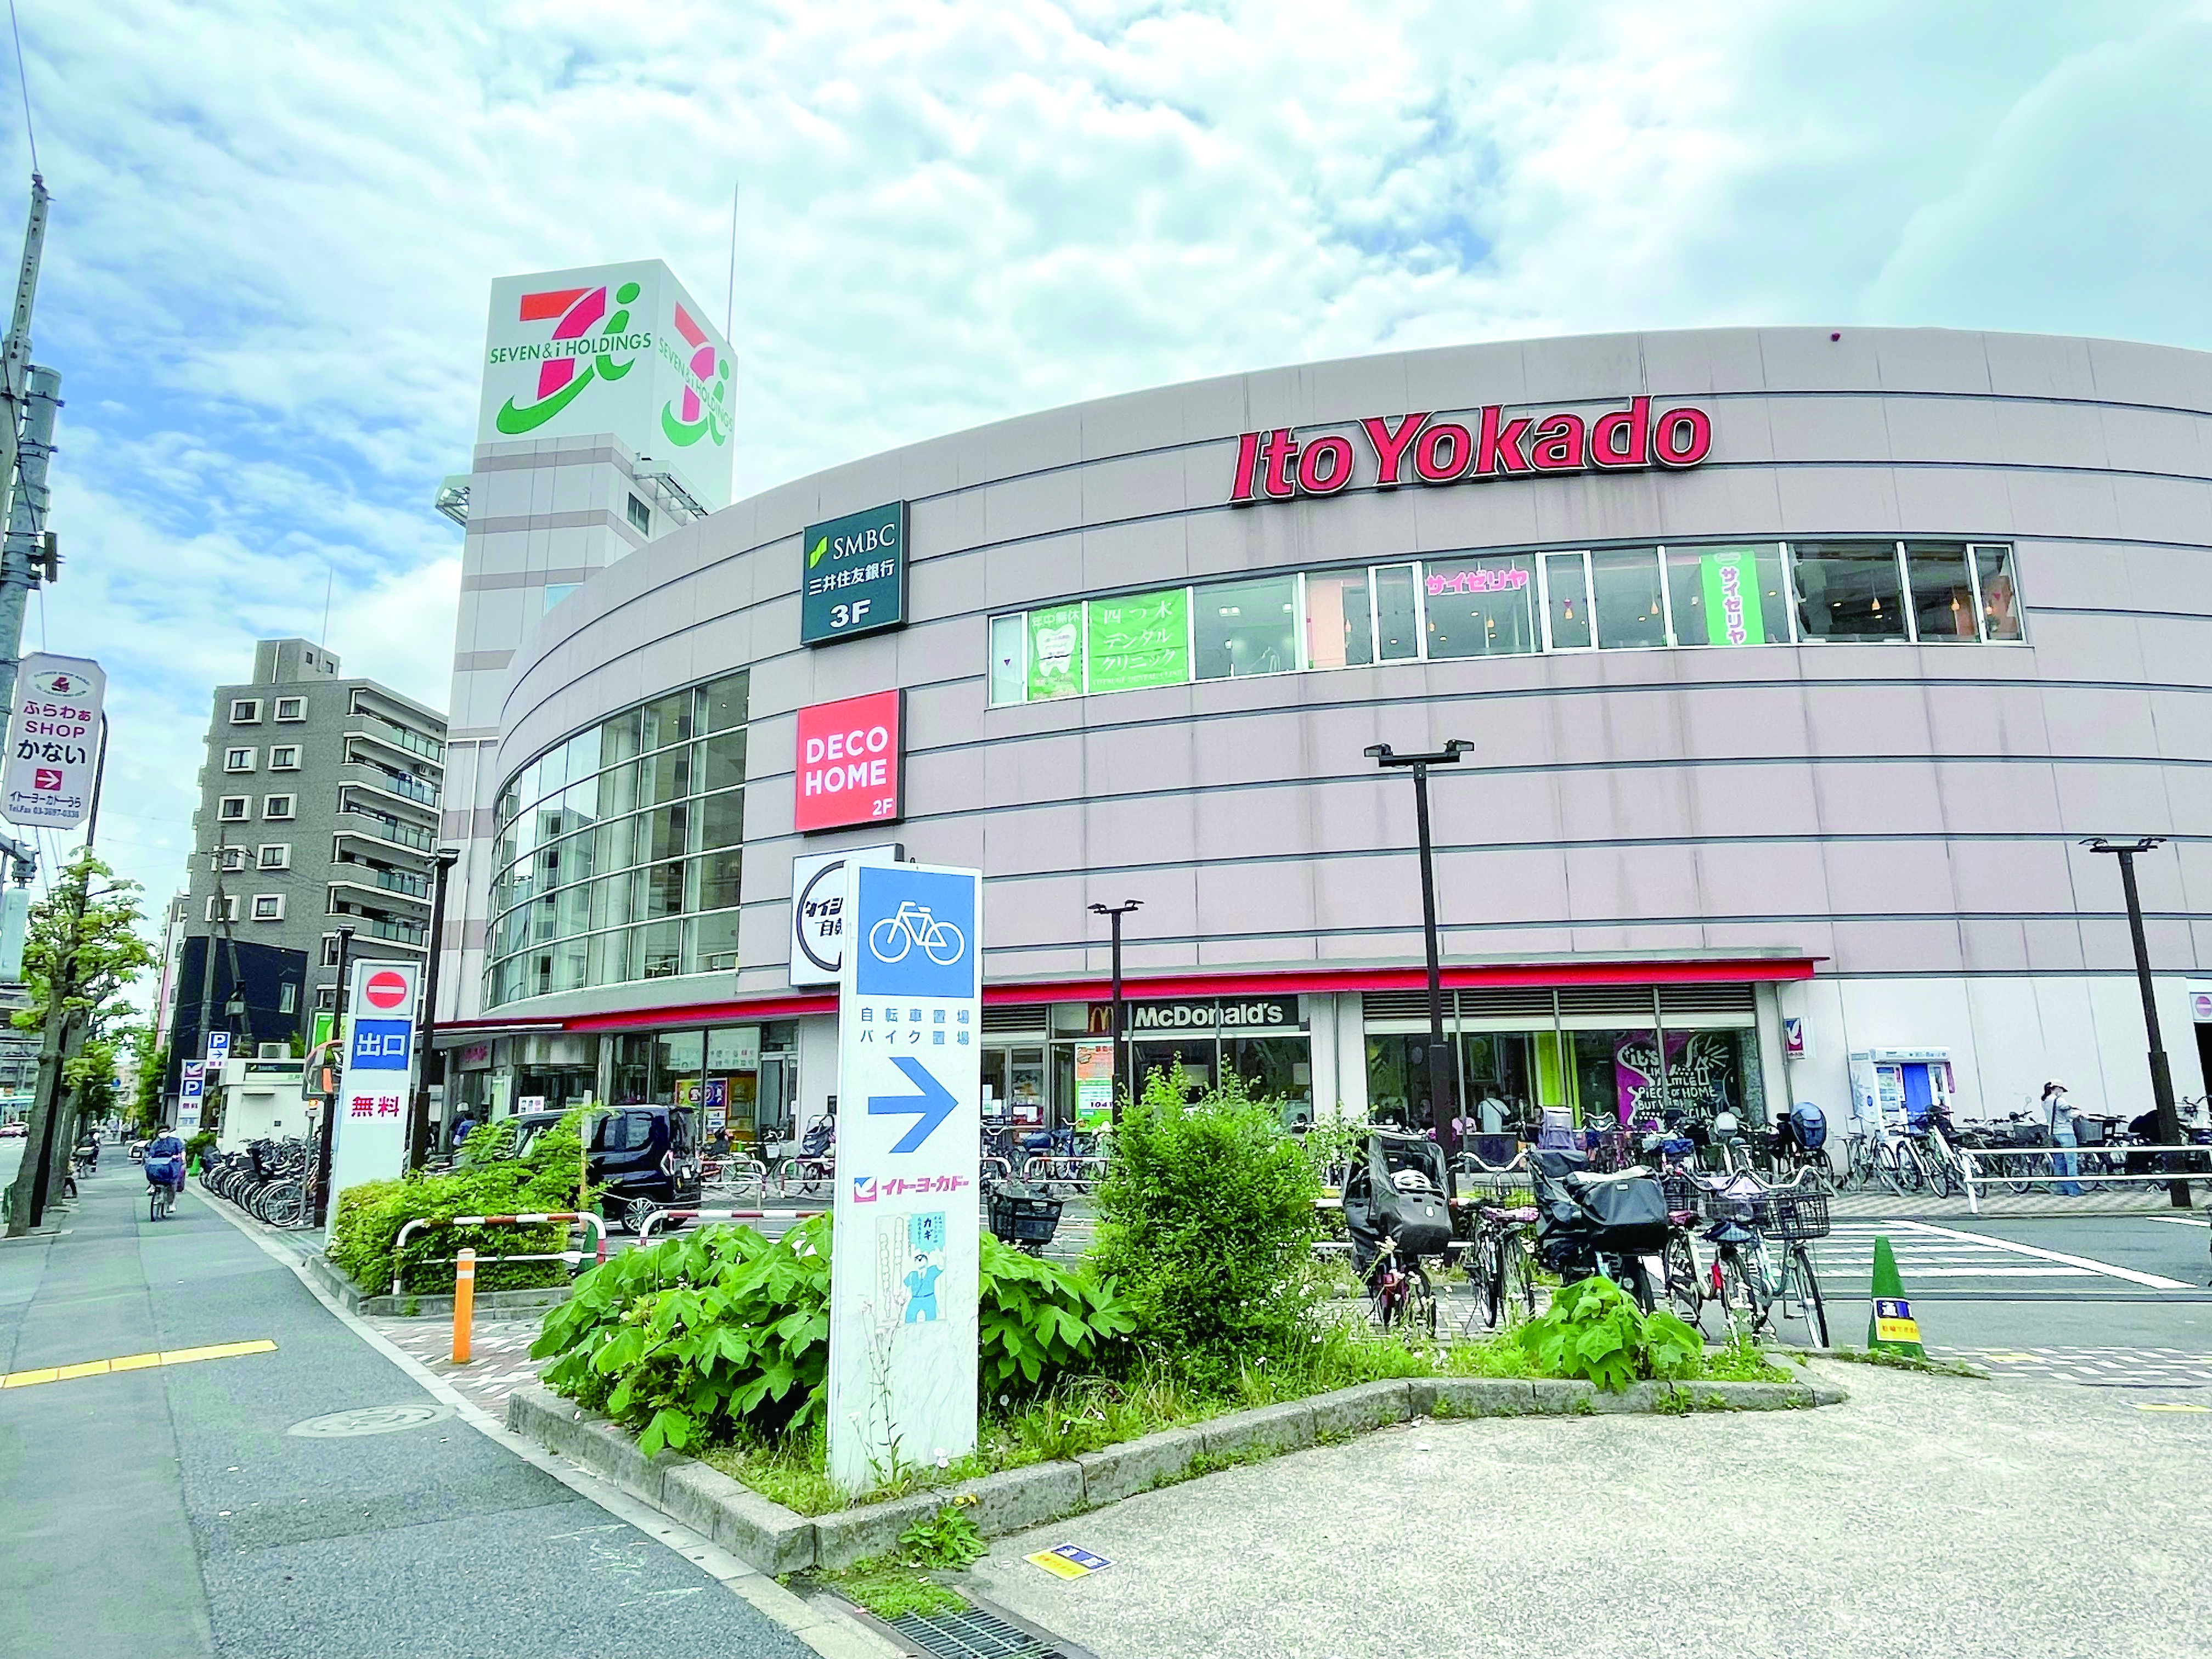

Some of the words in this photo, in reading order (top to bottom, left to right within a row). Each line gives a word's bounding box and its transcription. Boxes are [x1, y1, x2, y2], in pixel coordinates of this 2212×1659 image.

[566, 332, 652, 356] HOLDINGS
[696, 379, 733, 432] HOLDINGS
[1227, 427, 1355, 503] Ito
[1359, 395, 1712, 489] Yokado
[832, 523, 896, 561] SMBC
[808, 558, 895, 596] 三井住友銀行
[1425, 569, 1529, 596] サイゼリヤ
[830, 599, 872, 628] 3F
[1032, 610, 1080, 627] 年中無休
[1103, 600, 1172, 624] 四つ木
[1103, 627, 1172, 650] デンタル
[1100, 648, 1176, 673] クリニック
[25, 720, 85, 738] SHOP
[17, 739, 86, 765] かない
[805, 726, 888, 764] DECO
[804, 758, 888, 797] HOME
[872, 797, 893, 816] 2F
[860, 1007, 970, 1025] 自転車置場
[1134, 1002, 1284, 1027] McDonald's
[212, 1034, 227, 1047] P
[356, 1032, 406, 1057] 出口
[860, 1029, 970, 1046] バイク置場
[184, 1081, 199, 1096] P
[1681, 1086, 1719, 1098] HOME
[352, 1096, 400, 1118] 無料
[1638, 1099, 1656, 1110] BUT
[881, 1175, 969, 1196] イトーヨーカドー
